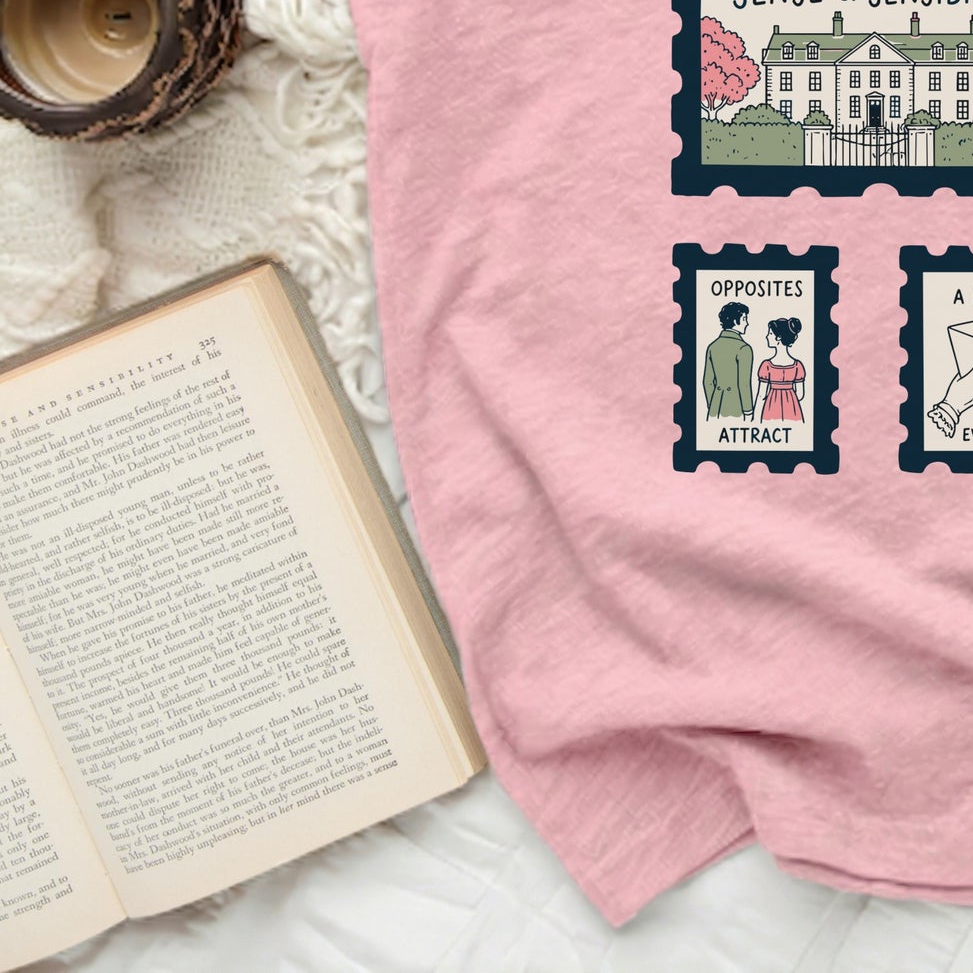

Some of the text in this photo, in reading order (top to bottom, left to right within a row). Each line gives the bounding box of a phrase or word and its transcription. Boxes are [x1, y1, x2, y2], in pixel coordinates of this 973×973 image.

[712, 280, 802, 297] OPPOSITES
[954, 289, 964, 304] A
[26, 335, 217, 417] AND SENSIBILITY 325
[719, 428, 791, 443] ATTRACT
